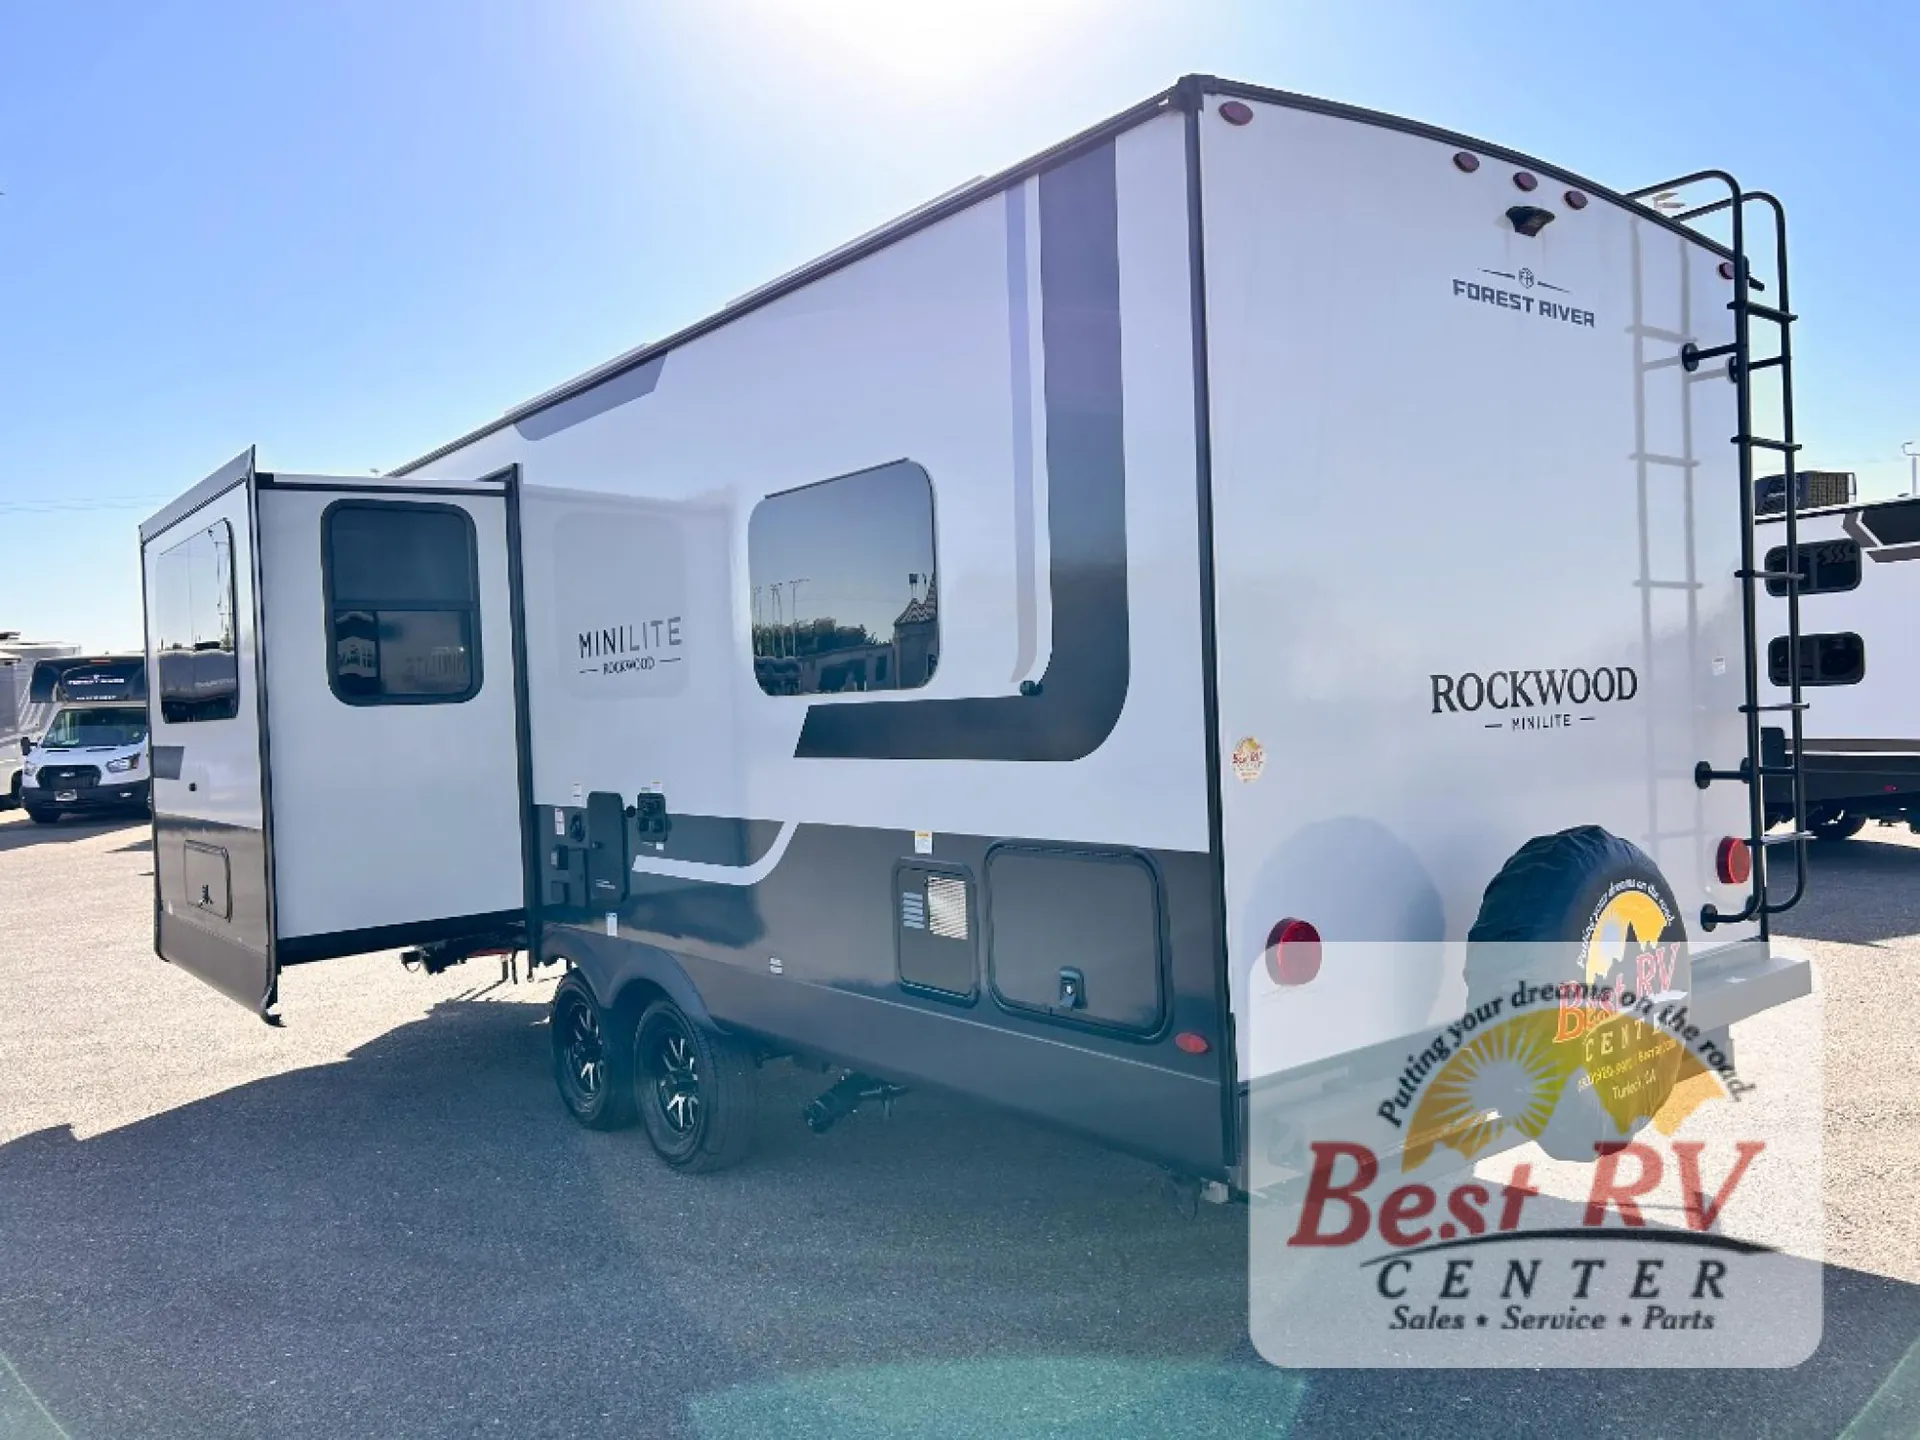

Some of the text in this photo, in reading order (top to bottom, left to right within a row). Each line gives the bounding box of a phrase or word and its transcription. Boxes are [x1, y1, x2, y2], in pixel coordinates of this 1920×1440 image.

[1452, 278, 1596, 328] FOREST RIVER
[578, 616, 682, 659] MINILITE
[603, 655, 656, 675] ROCKWOOD
[1429, 666, 1638, 714] ROCKWOOD
[1511, 713, 1572, 731] MINILITE
[1552, 942, 1681, 1044] Best RV
